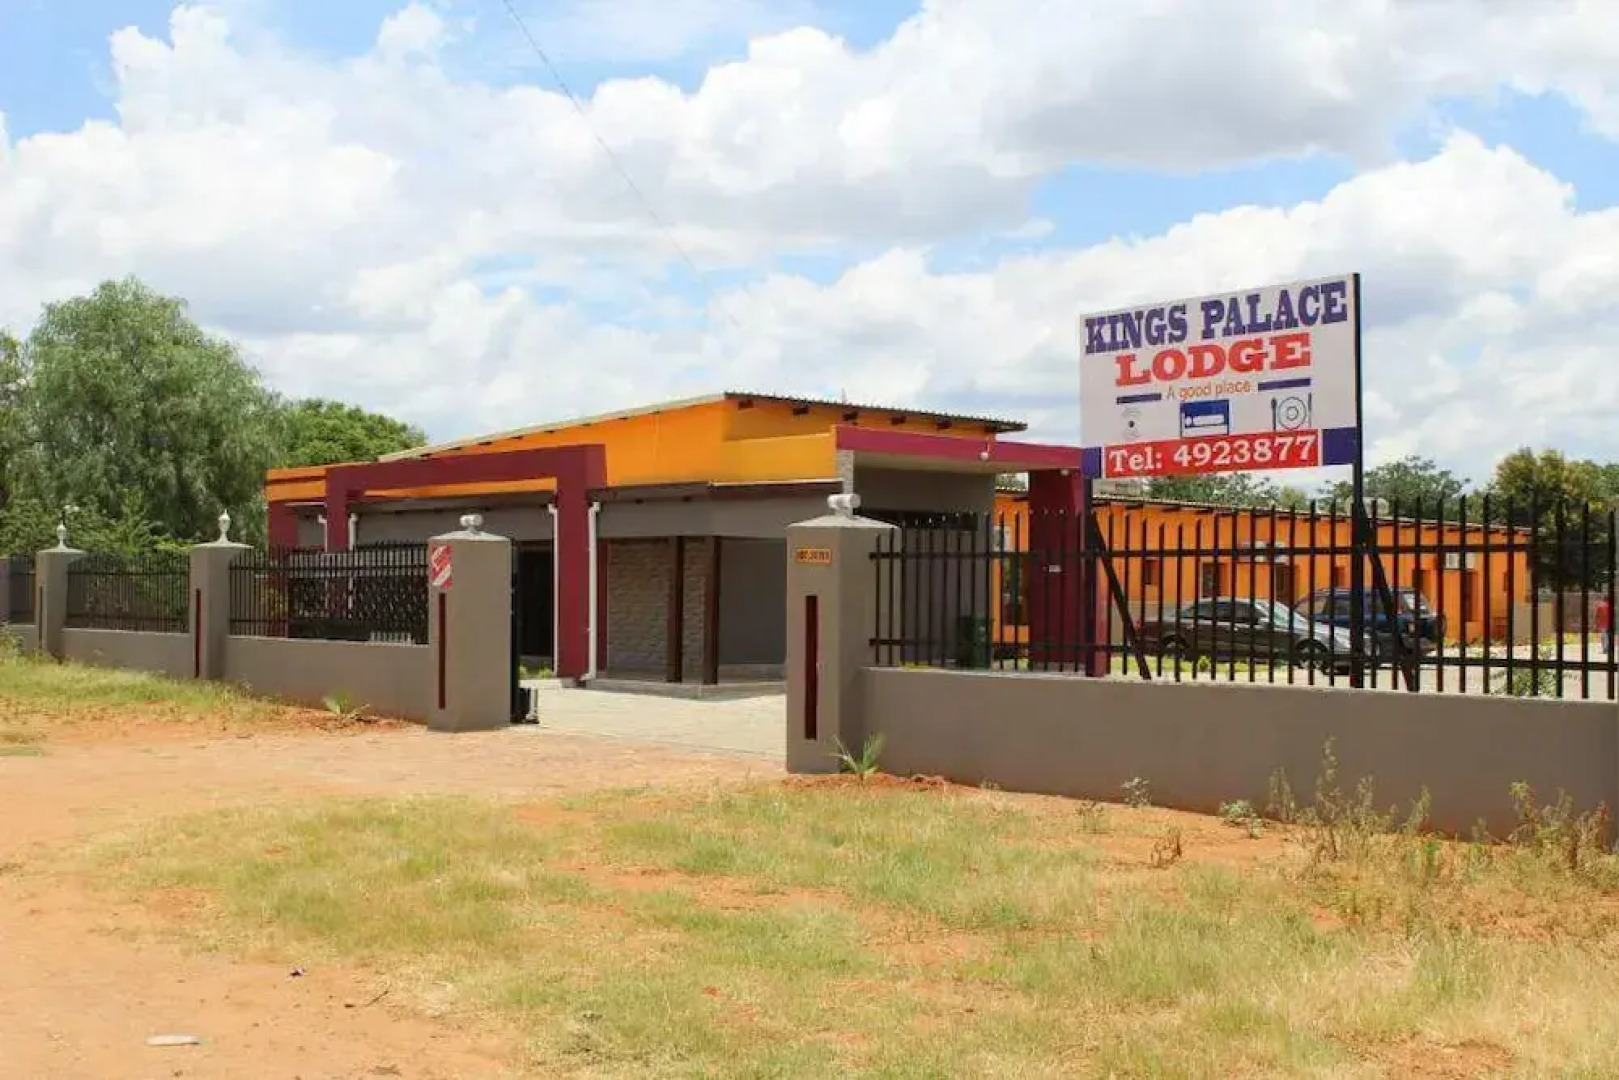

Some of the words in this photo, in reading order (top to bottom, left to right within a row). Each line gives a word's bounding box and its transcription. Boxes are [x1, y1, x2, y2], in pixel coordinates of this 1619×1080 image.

[1085, 304, 1188, 354] KINGS
[1201, 280, 1348, 339] PALACE
[1115, 332, 1312, 387] LODGE
[1166, 385, 1176, 399] A
[1179, 382, 1212, 399] good
[1215, 379, 1252, 397] place
[1108, 446, 1163, 472] Tel:
[1173, 435, 1316, 467] 4923877
